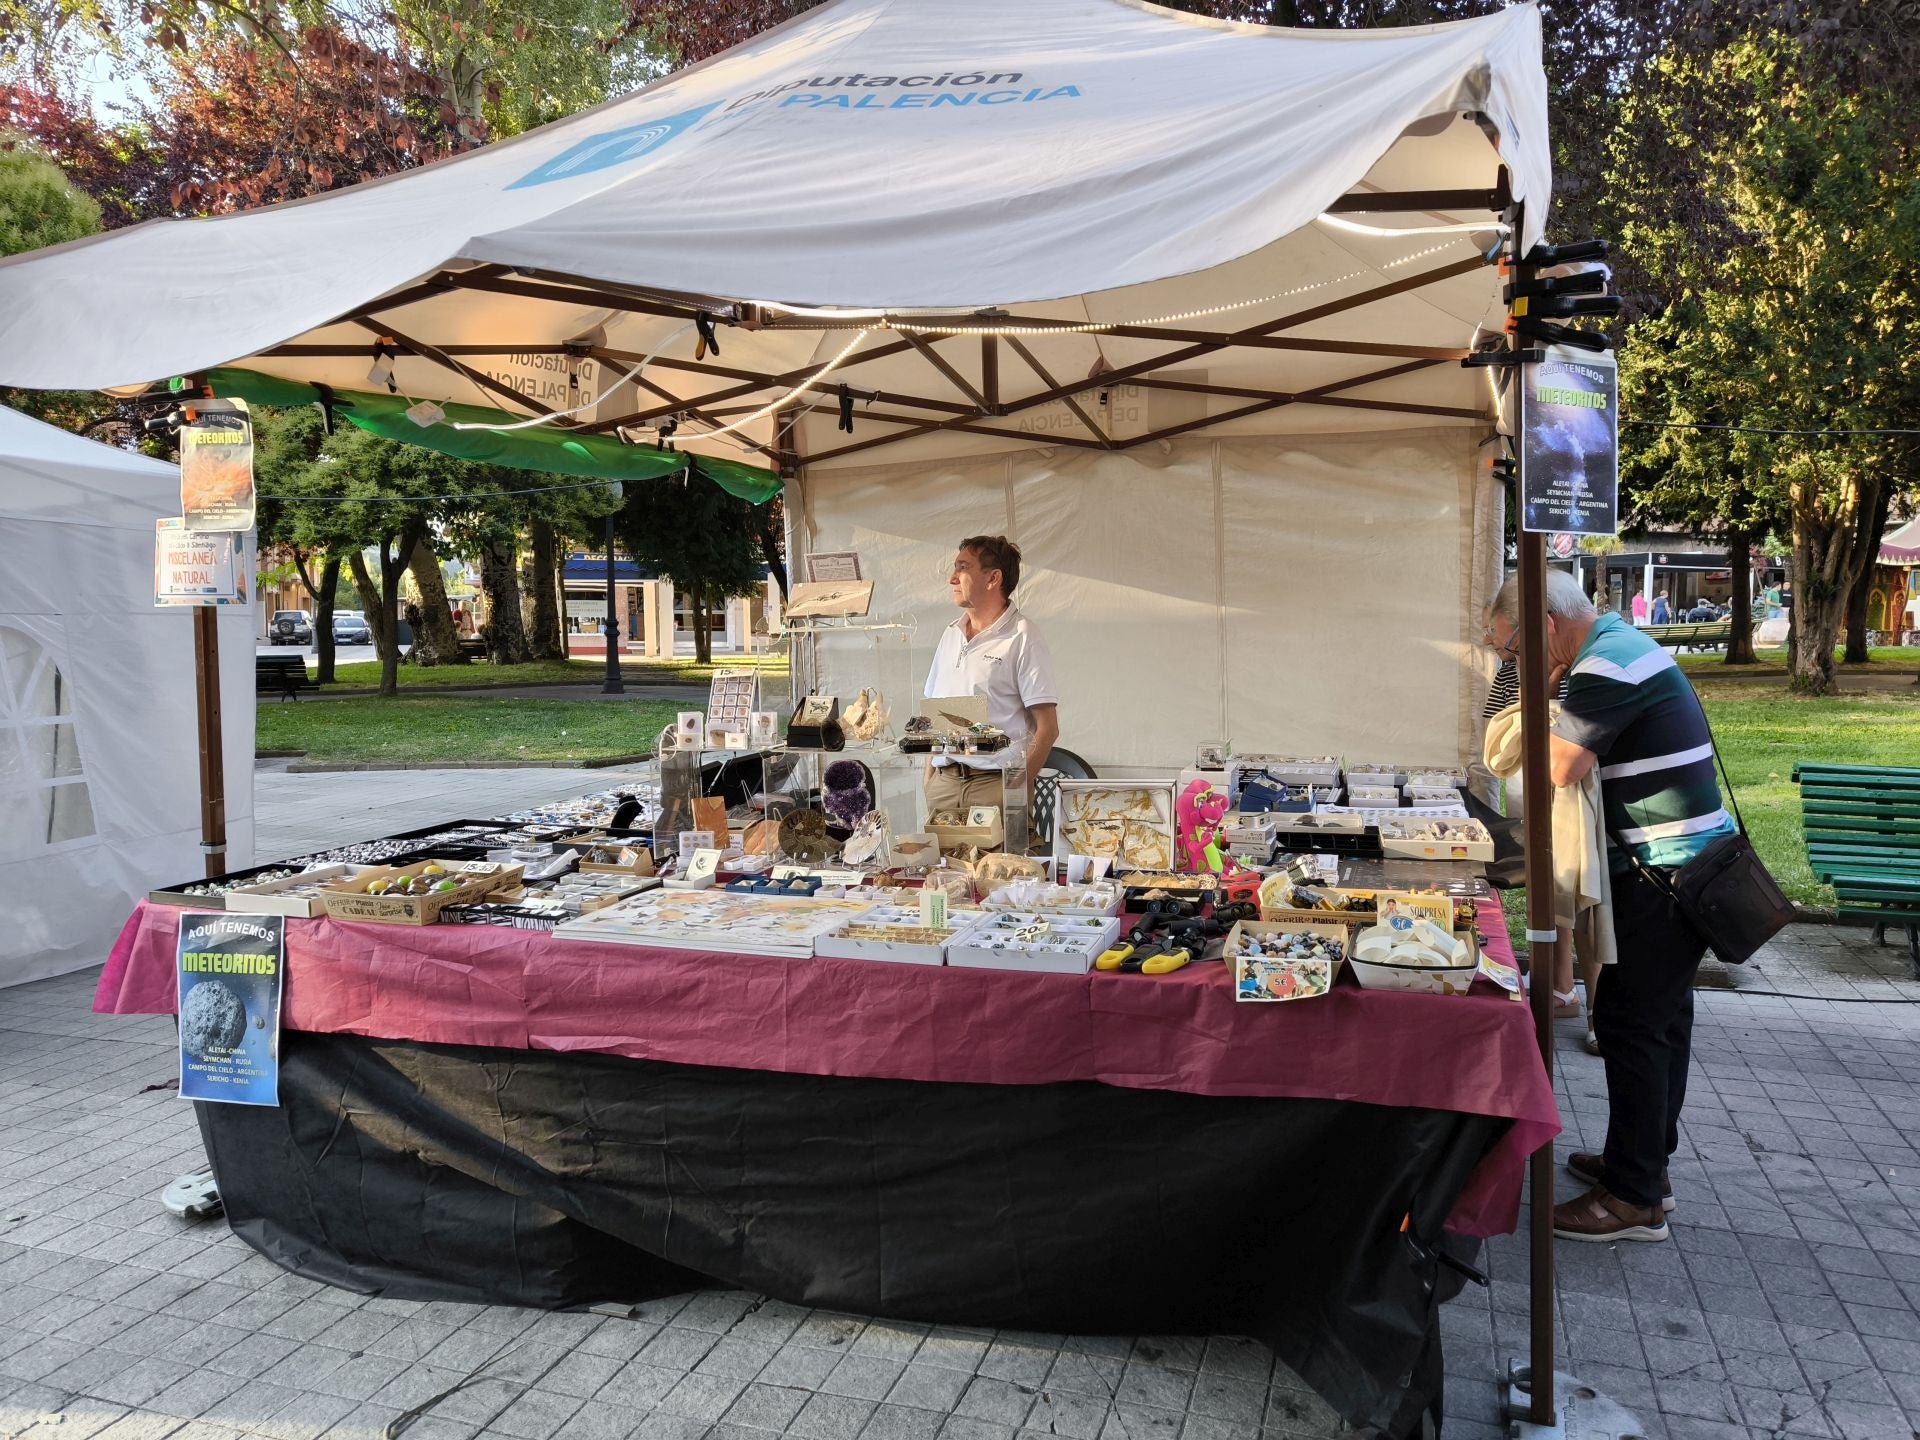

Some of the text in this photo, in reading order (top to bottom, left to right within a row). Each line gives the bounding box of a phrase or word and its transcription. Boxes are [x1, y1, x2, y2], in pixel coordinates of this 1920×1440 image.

[723, 71, 1023, 112] Diputación
[777, 85, 1082, 109] PALENCIA
[1563, 363, 1604, 384] TENEMOS
[1536, 387, 1607, 410] METEORITOS
[190, 431, 244, 445] METEORITOS
[1530, 496, 1550, 505] CAMPO
[1578, 500, 1609, 509] ARGENTINA
[172, 571, 211, 584] NATURAL
[1410, 906, 1446, 919] SORPRESA
[1312, 917, 1338, 925] Plaisir
[188, 920, 275, 942] AQUÍ TENEMOS
[182, 952, 276, 975] METEORITOS
[208, 1046, 226, 1054] ALETAI
[188, 1063, 207, 1071] CAMPO
[219, 1066, 234, 1074] CIELO
